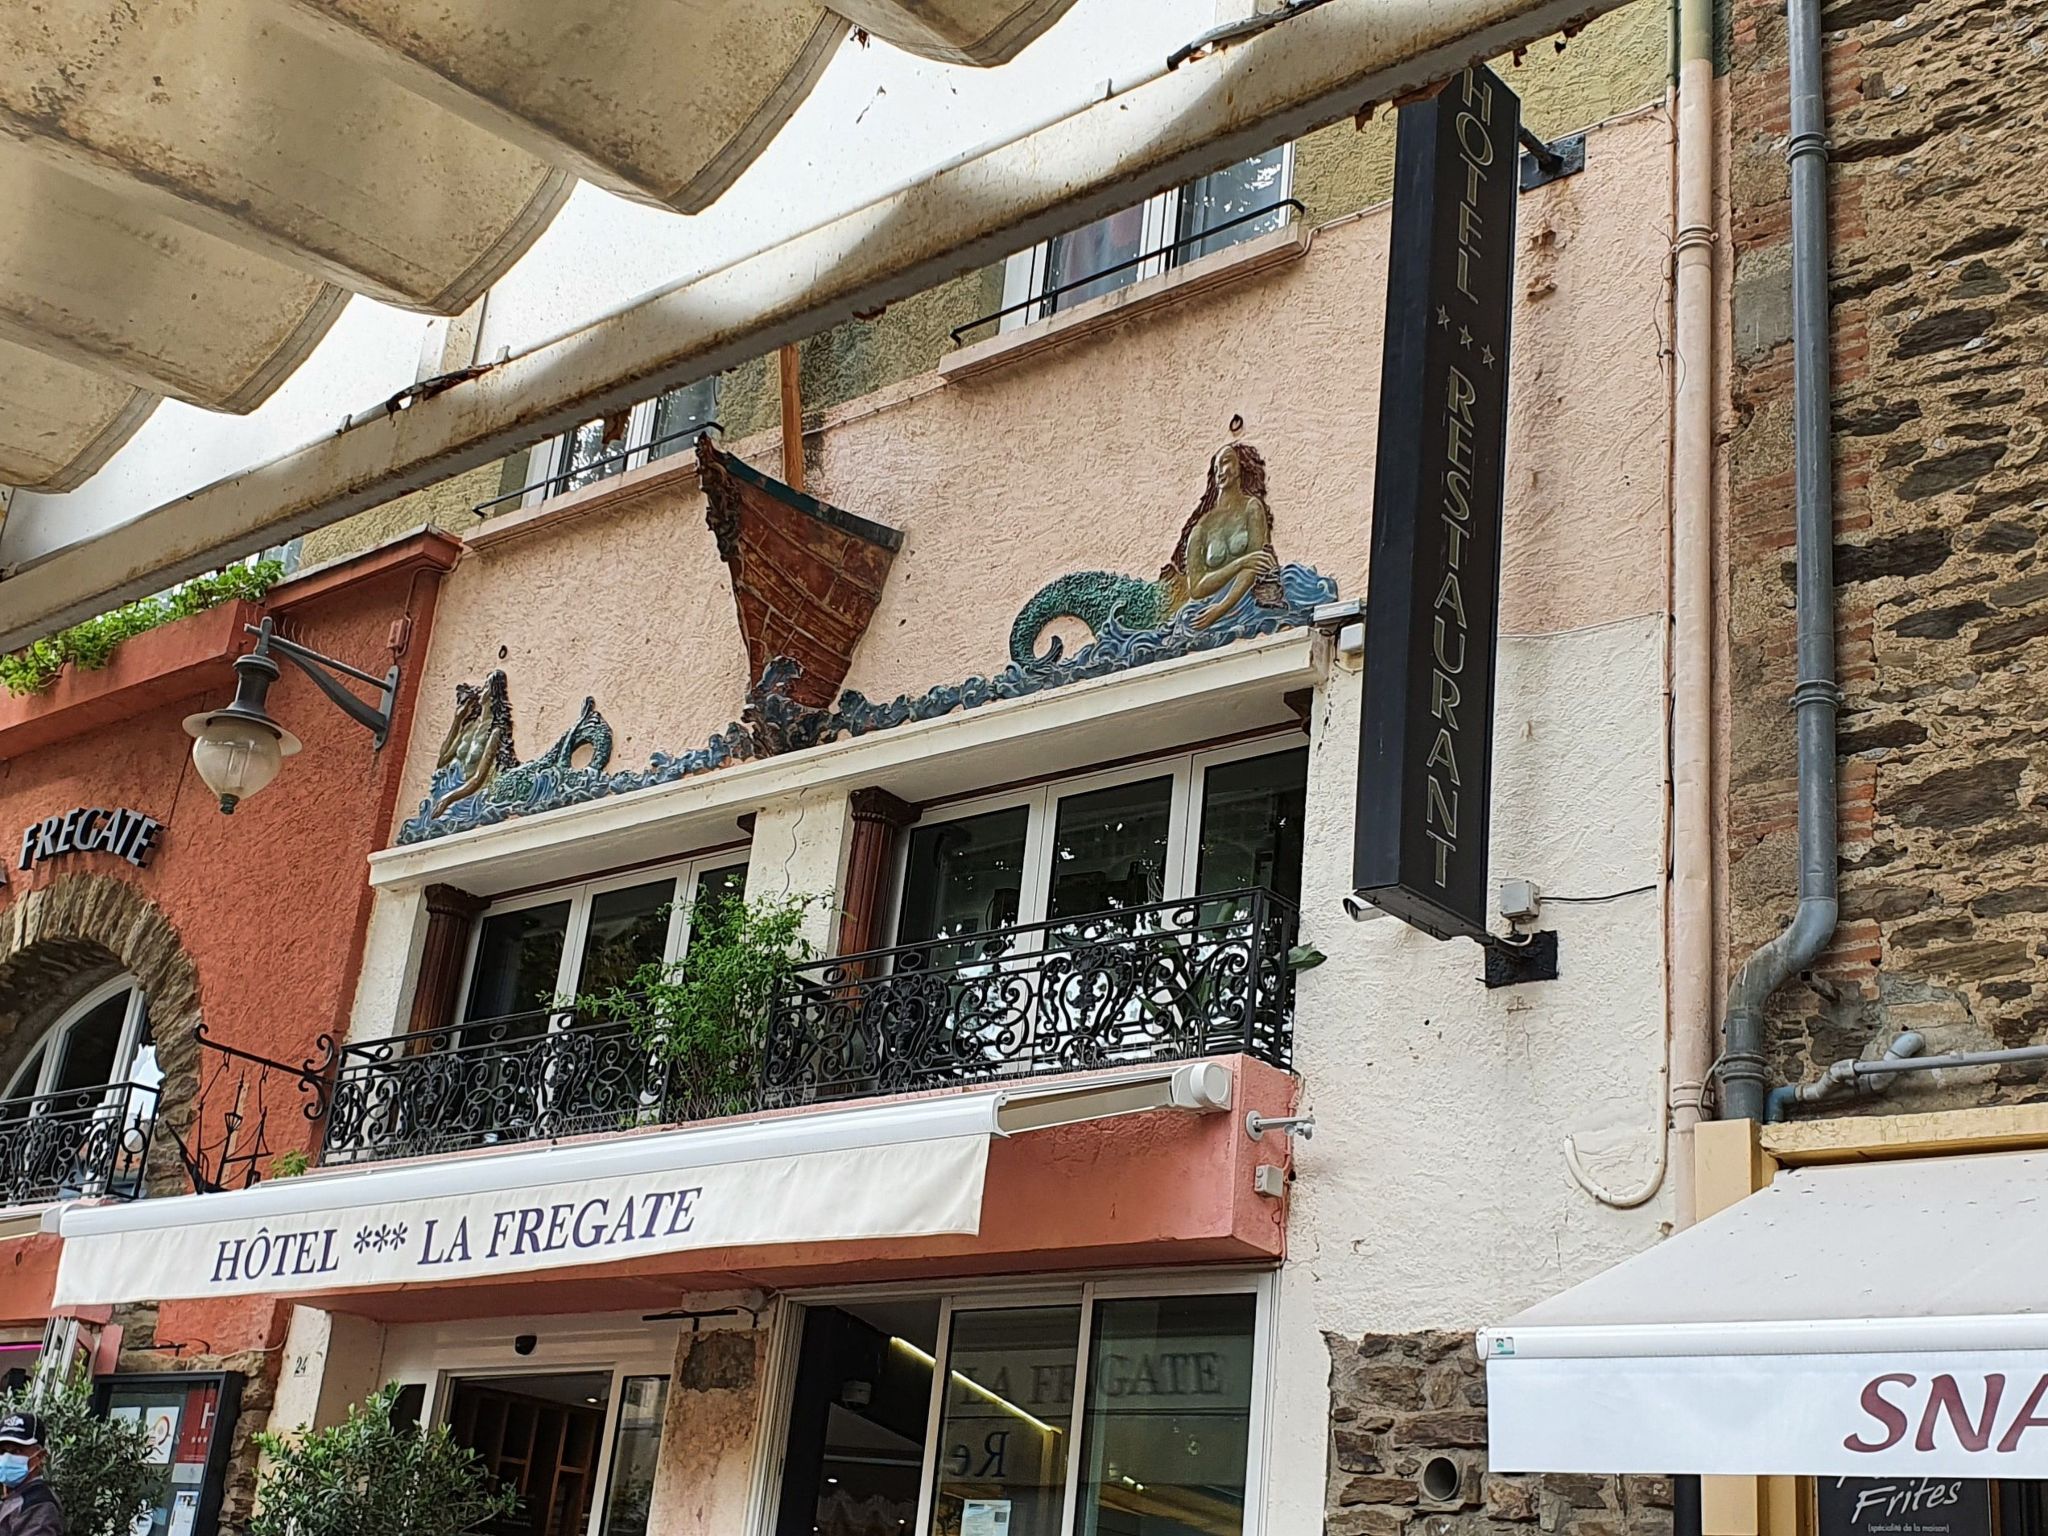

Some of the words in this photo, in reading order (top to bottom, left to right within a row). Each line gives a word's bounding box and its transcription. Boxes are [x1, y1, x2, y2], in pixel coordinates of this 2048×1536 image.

[1456, 67, 1493, 304] HOTEL
[1426, 365, 1476, 889] RESTAURANT
[18, 807, 162, 869] FREGATE
[210, 1226, 340, 1282] HÔTEL
[417, 1216, 472, 1265] LA
[486, 1187, 703, 1259] FREGATE
[294, 1356, 309, 1374] 24
[1850, 1477, 1962, 1524] Frites
